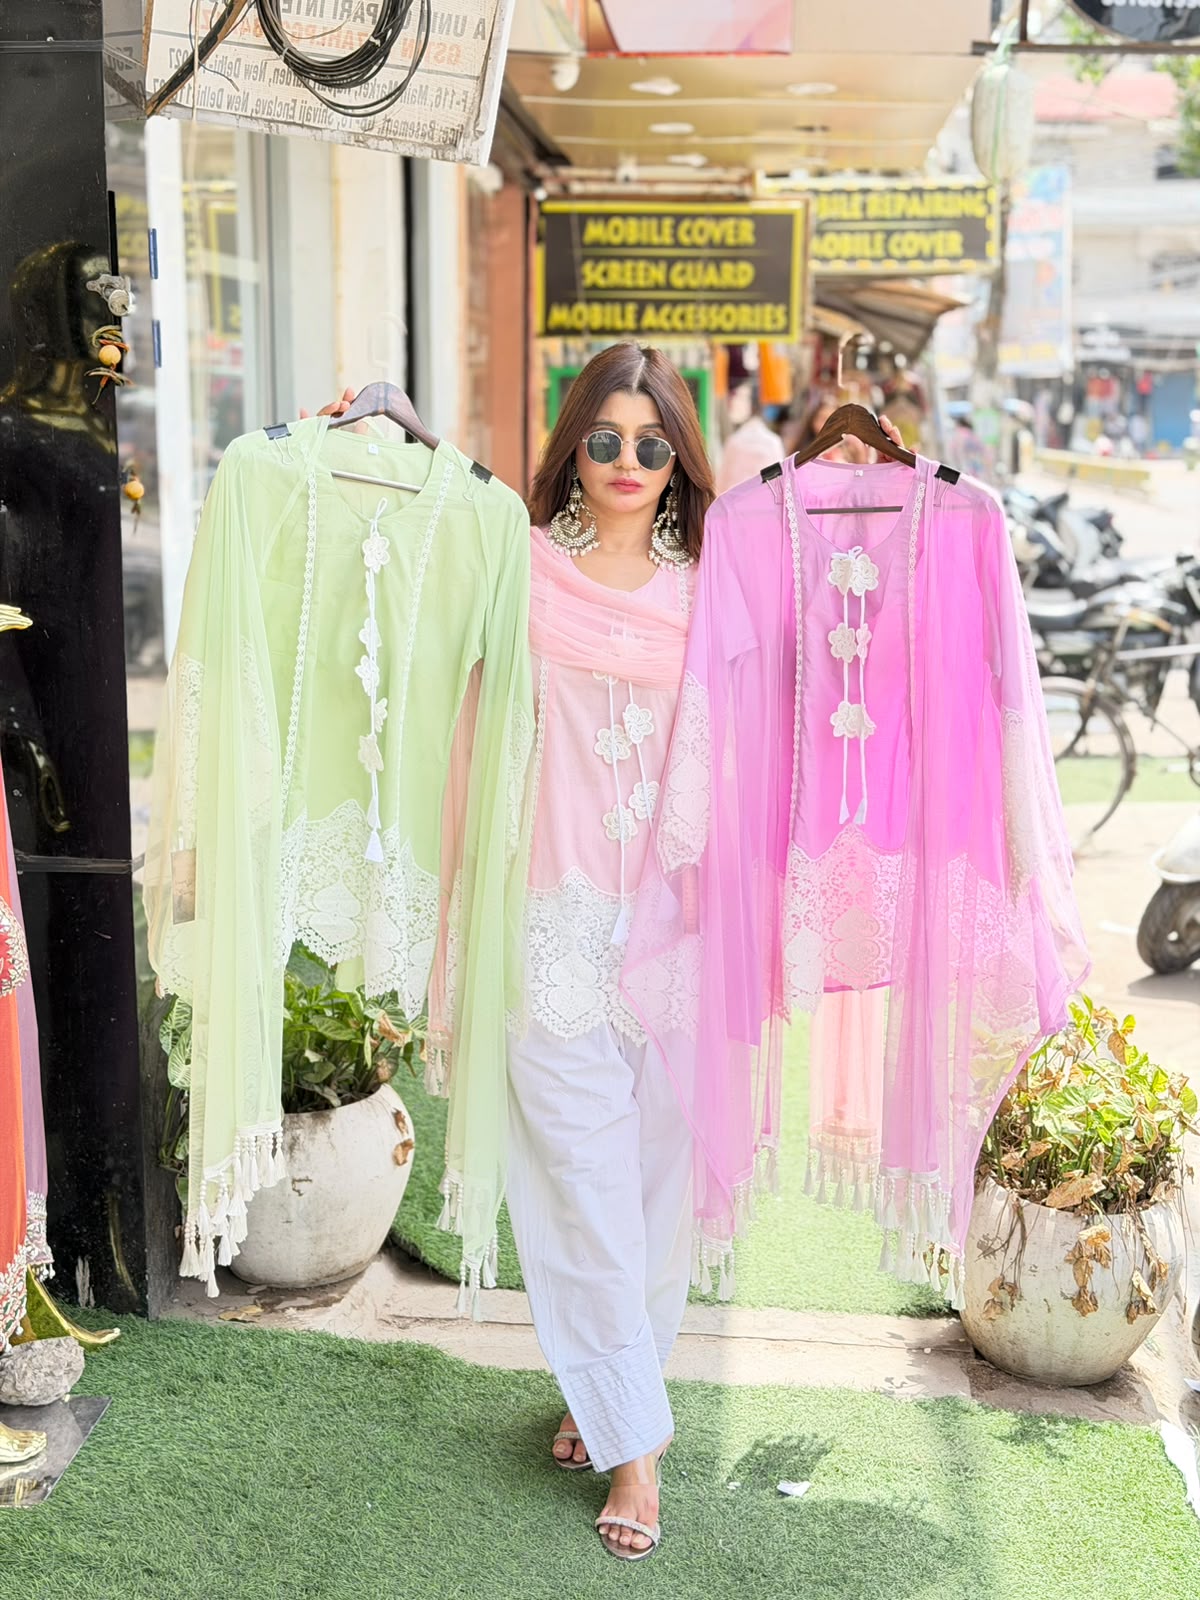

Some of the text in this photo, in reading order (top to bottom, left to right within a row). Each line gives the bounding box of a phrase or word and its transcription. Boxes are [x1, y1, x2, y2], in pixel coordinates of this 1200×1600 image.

[866, 190, 989, 219] REPAIRING
[582, 216, 756, 247] MOBILE COVER
[887, 229, 964, 258] COVER
[580, 259, 756, 289] SCREEN GUARD
[547, 302, 788, 333] MOBILE ACCESSORIES
